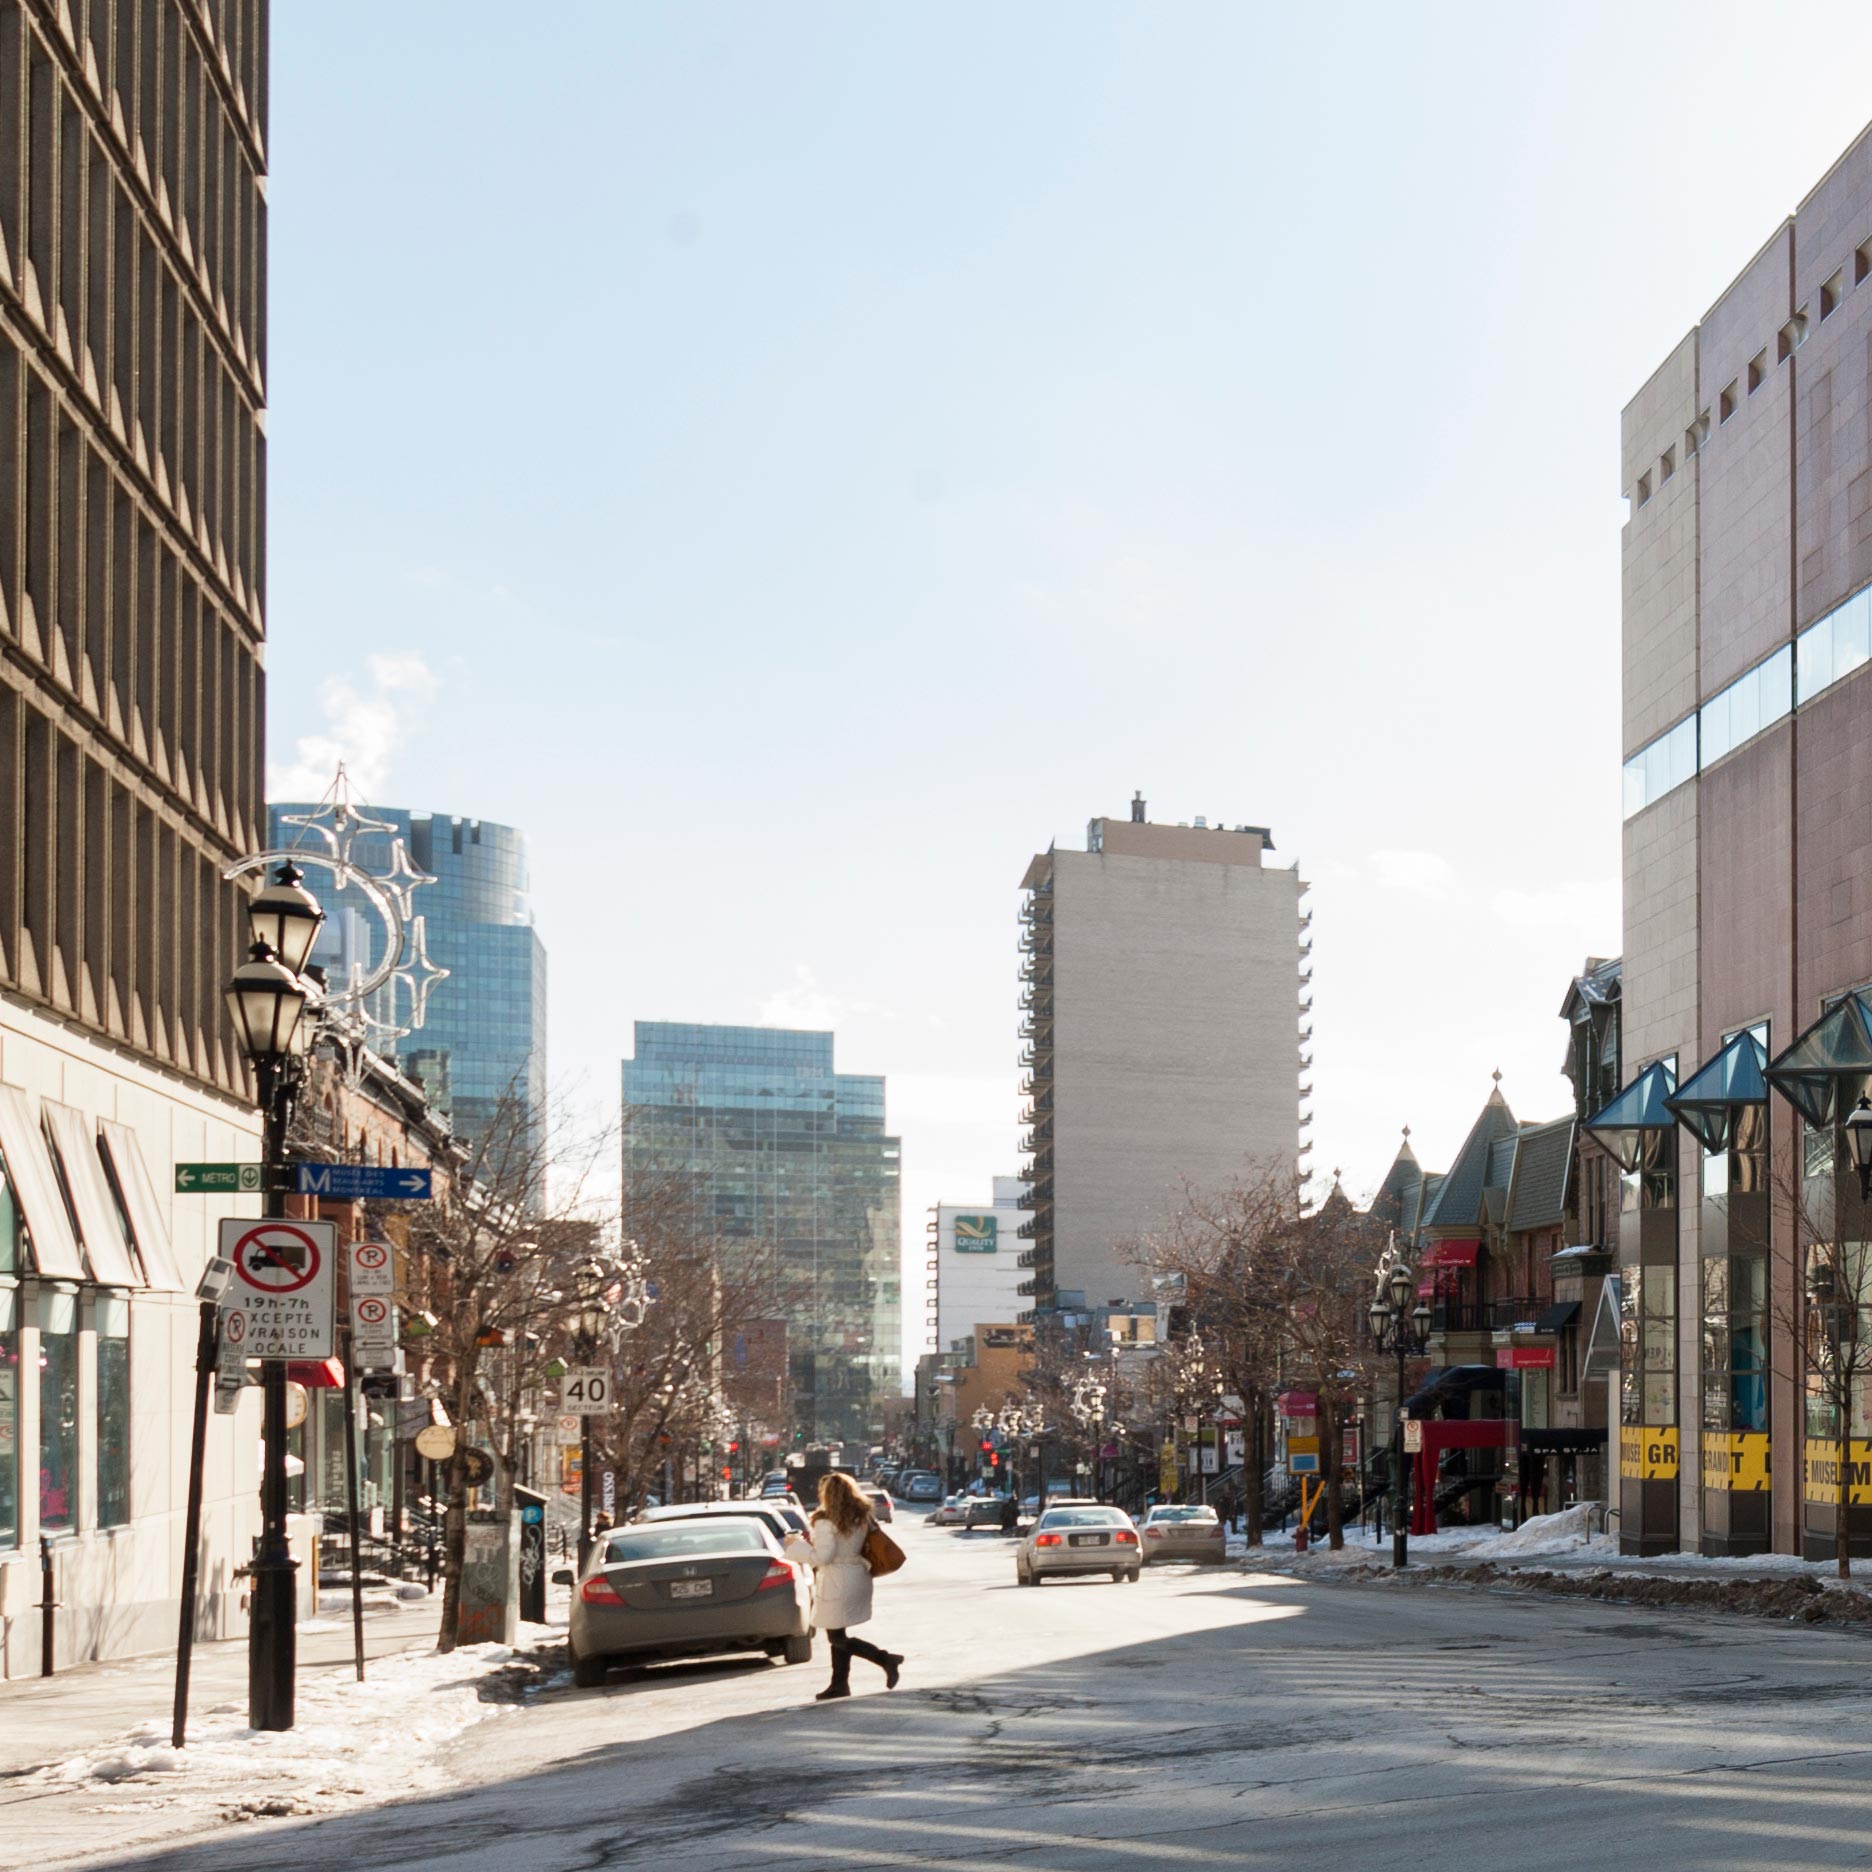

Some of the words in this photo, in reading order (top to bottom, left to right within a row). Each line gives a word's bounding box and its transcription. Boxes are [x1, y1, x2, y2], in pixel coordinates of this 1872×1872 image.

[957, 1237, 994, 1246] QUALITY
[245, 1297, 309, 1309] 19h-7h
[251, 1311, 313, 1324] XCEPTÉ
[567, 1378, 605, 1402] 40
[1533, 1447, 1558, 1455] SPA
